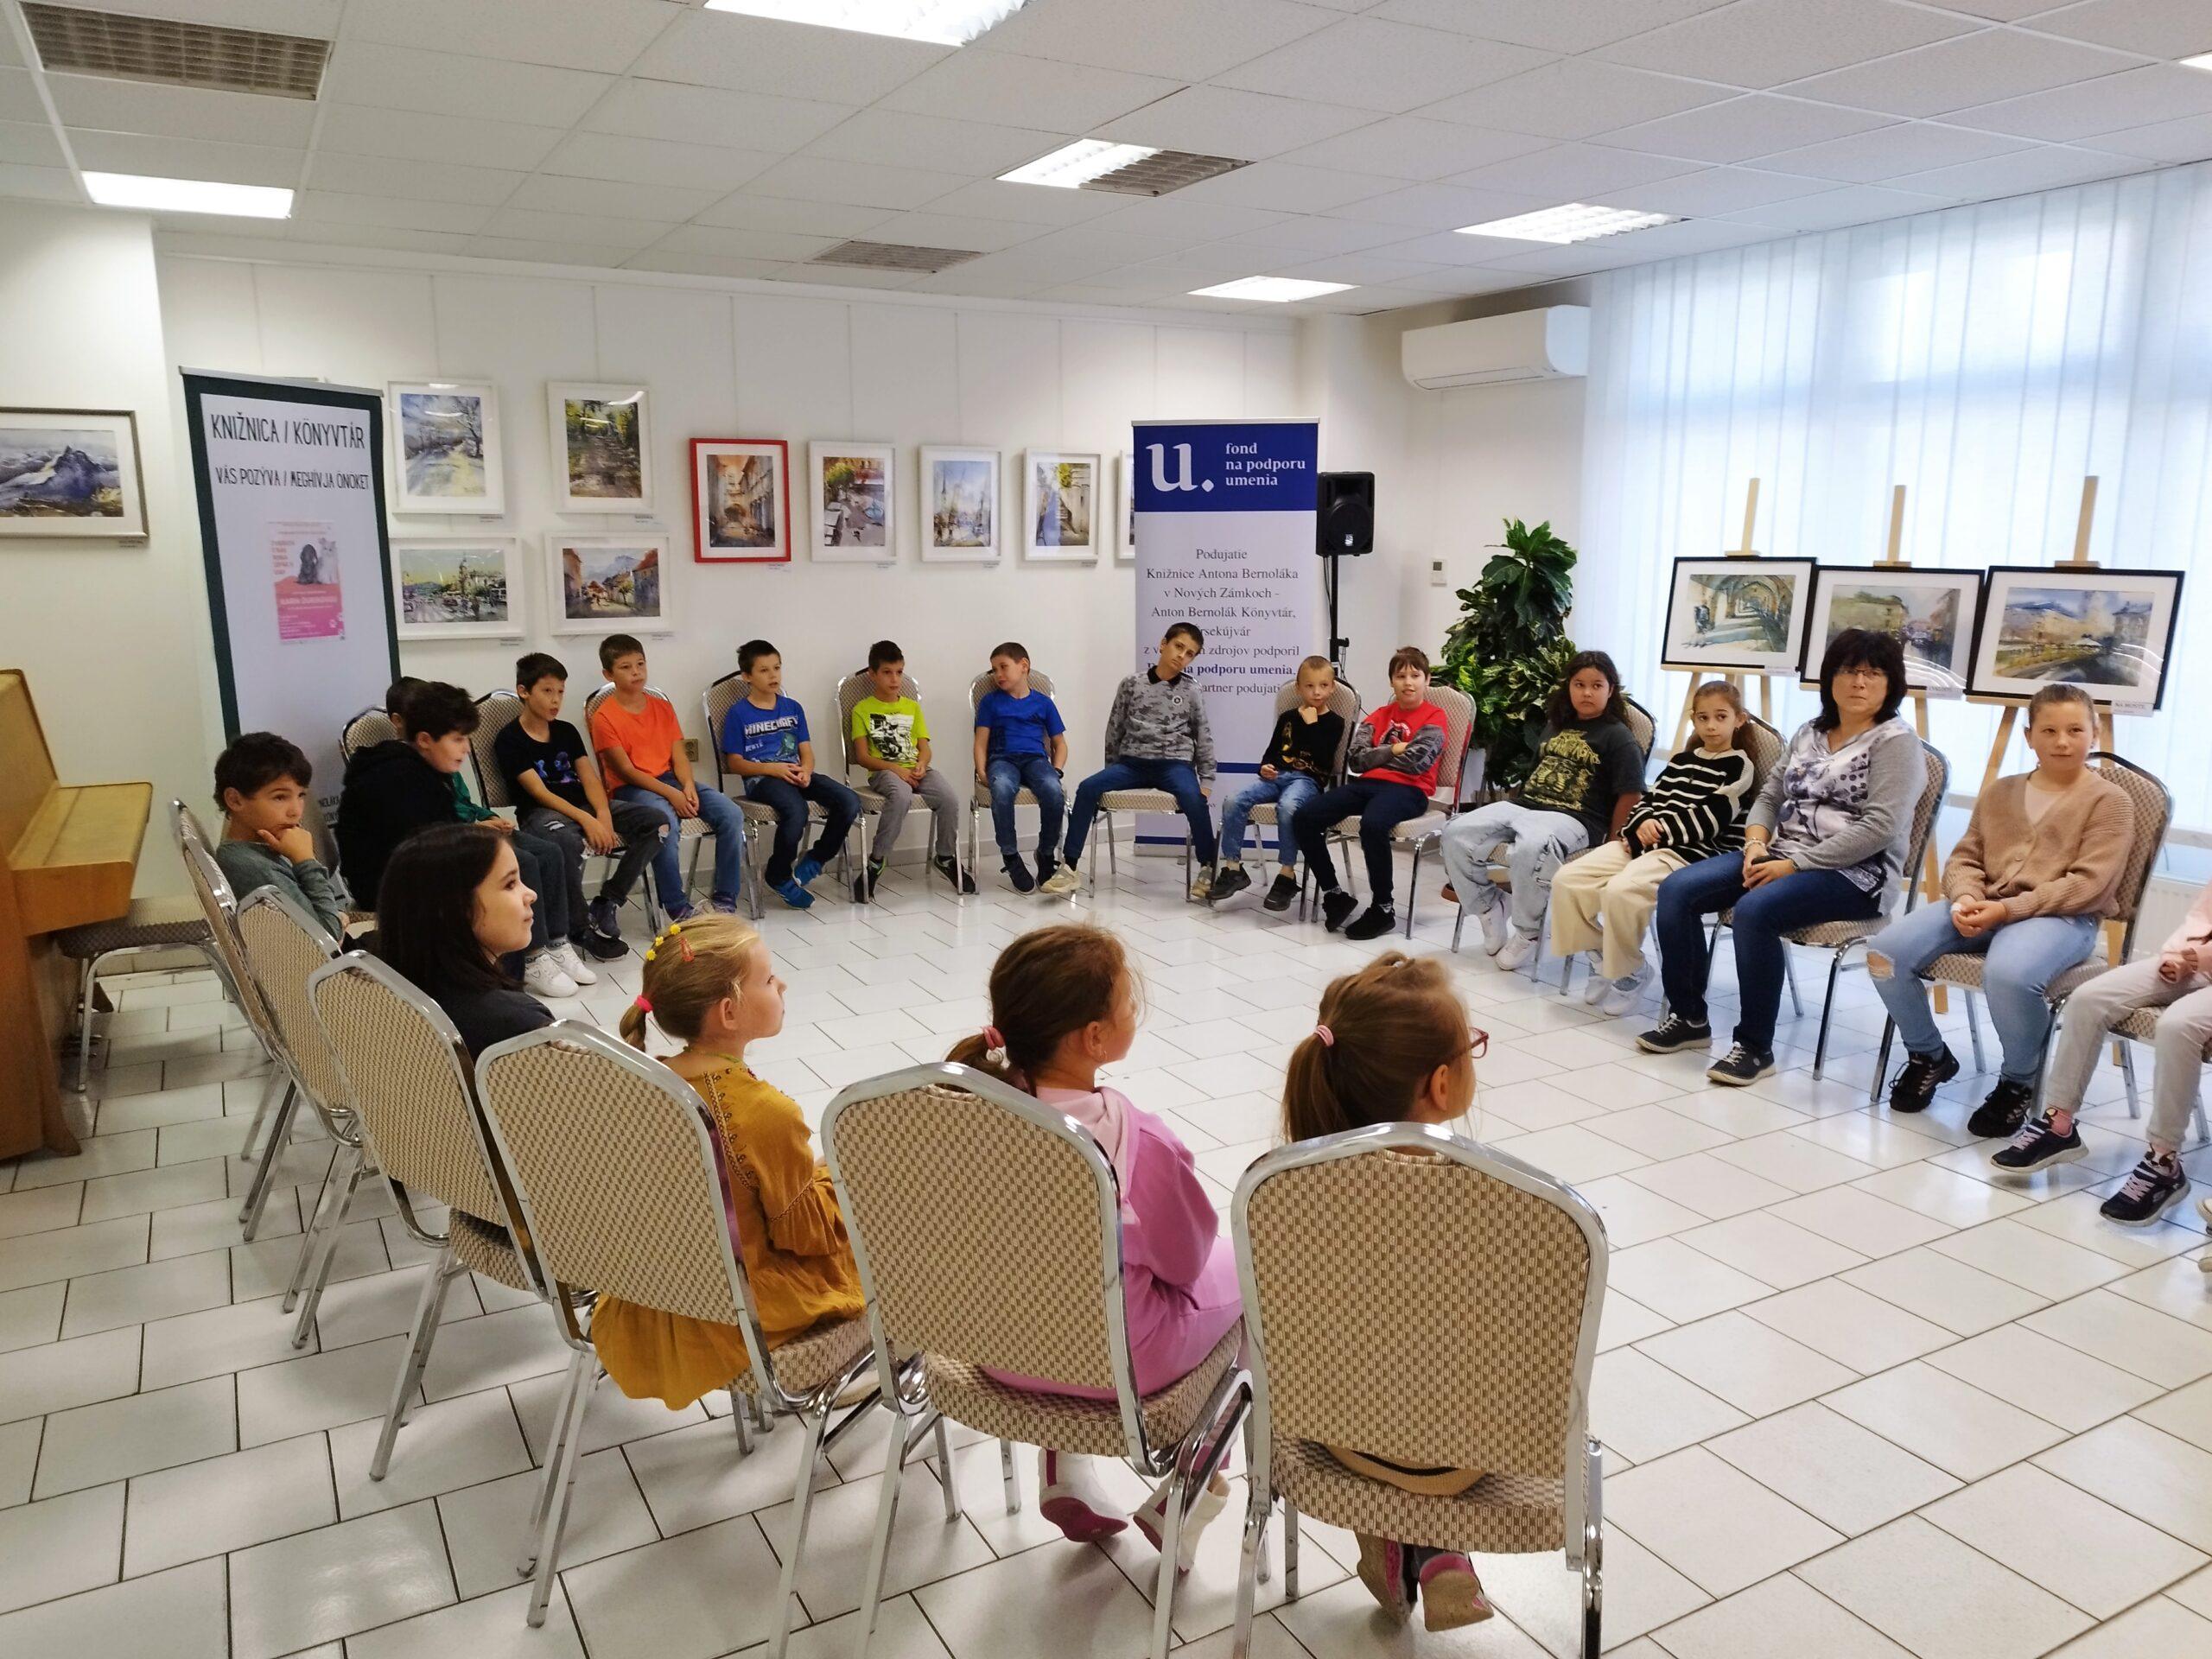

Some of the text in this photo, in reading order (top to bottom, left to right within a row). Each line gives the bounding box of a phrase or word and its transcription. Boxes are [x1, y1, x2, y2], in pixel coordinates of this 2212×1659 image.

[211, 411, 280, 443] KNIŽNICA
[293, 417, 365, 448] KÖNYVTÁR
[1225, 442, 1257, 454] fond
[1225, 458, 1306, 473] na podporu
[215, 465, 238, 485] VÁS
[1225, 474, 1278, 486] umenia
[1196, 549, 1248, 562] Podujatie
[1147, 568, 1299, 579] Knižnice Antona Bernoláka
[1174, 588, 1217, 601] Nových
[1220, 587, 1272, 598] Zámkoch
[1152, 607, 1185, 618] Anton
[1188, 607, 1237, 617] Bernolák
[1196, 624, 1251, 639] rsekújvár
[1209, 645, 1249, 658] zdrojov
[1253, 646, 1300, 658] podporil
[1197, 664, 1246, 676] podporu
[1202, 683, 1281, 696] artner podujati
